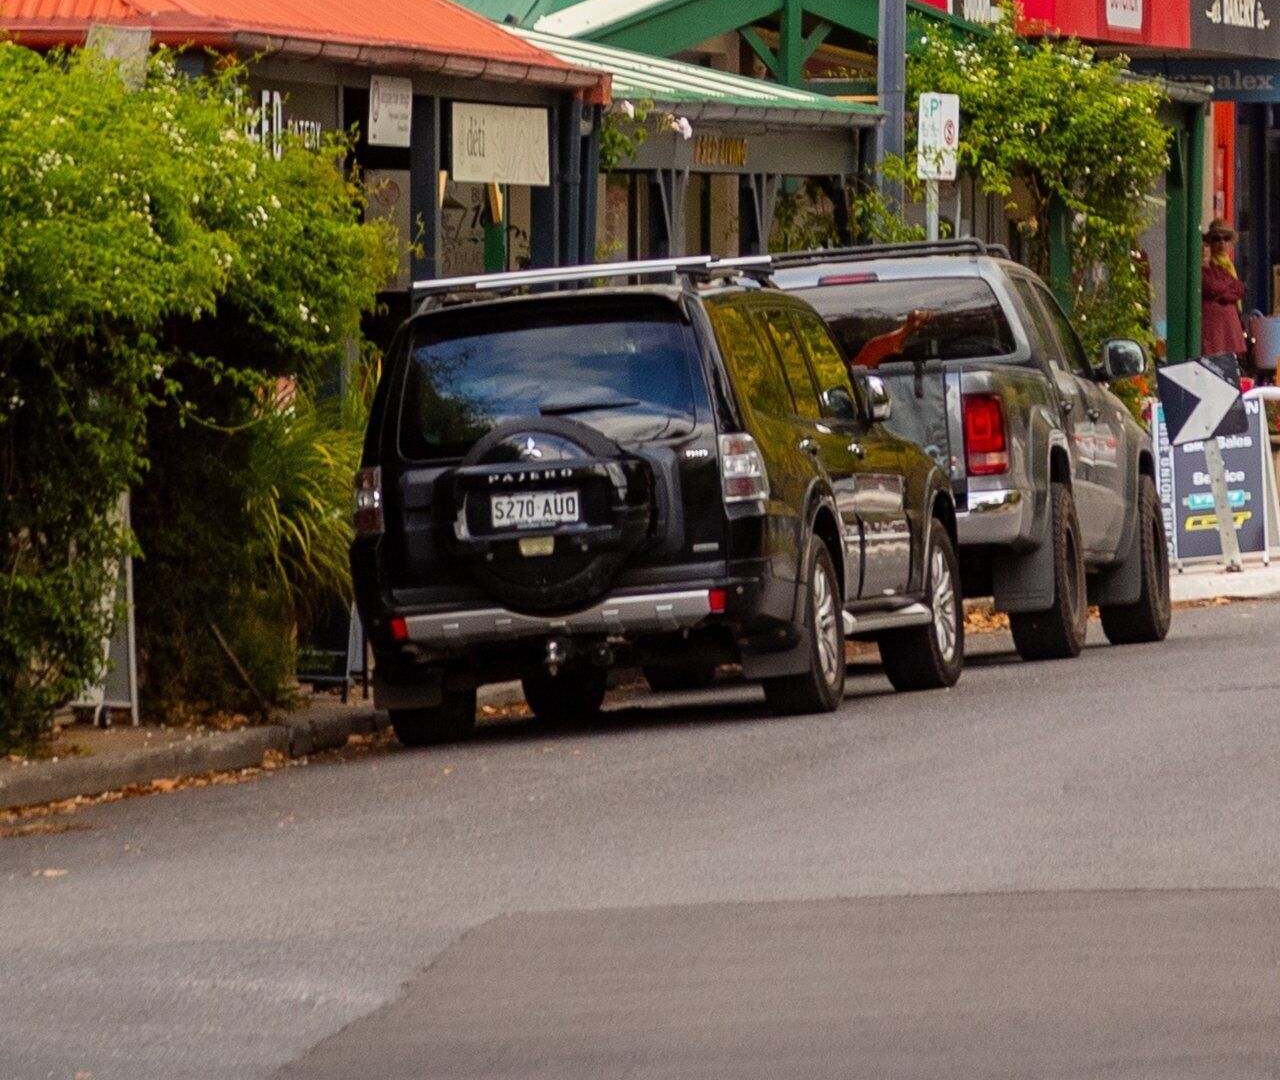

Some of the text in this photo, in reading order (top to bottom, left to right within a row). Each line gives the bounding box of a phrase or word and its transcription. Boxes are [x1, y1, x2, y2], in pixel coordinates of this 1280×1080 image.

[488, 468, 573, 483] PAJERO
[1160, 458, 1173, 506] UNION
[1192, 470, 1246, 486] Seice
